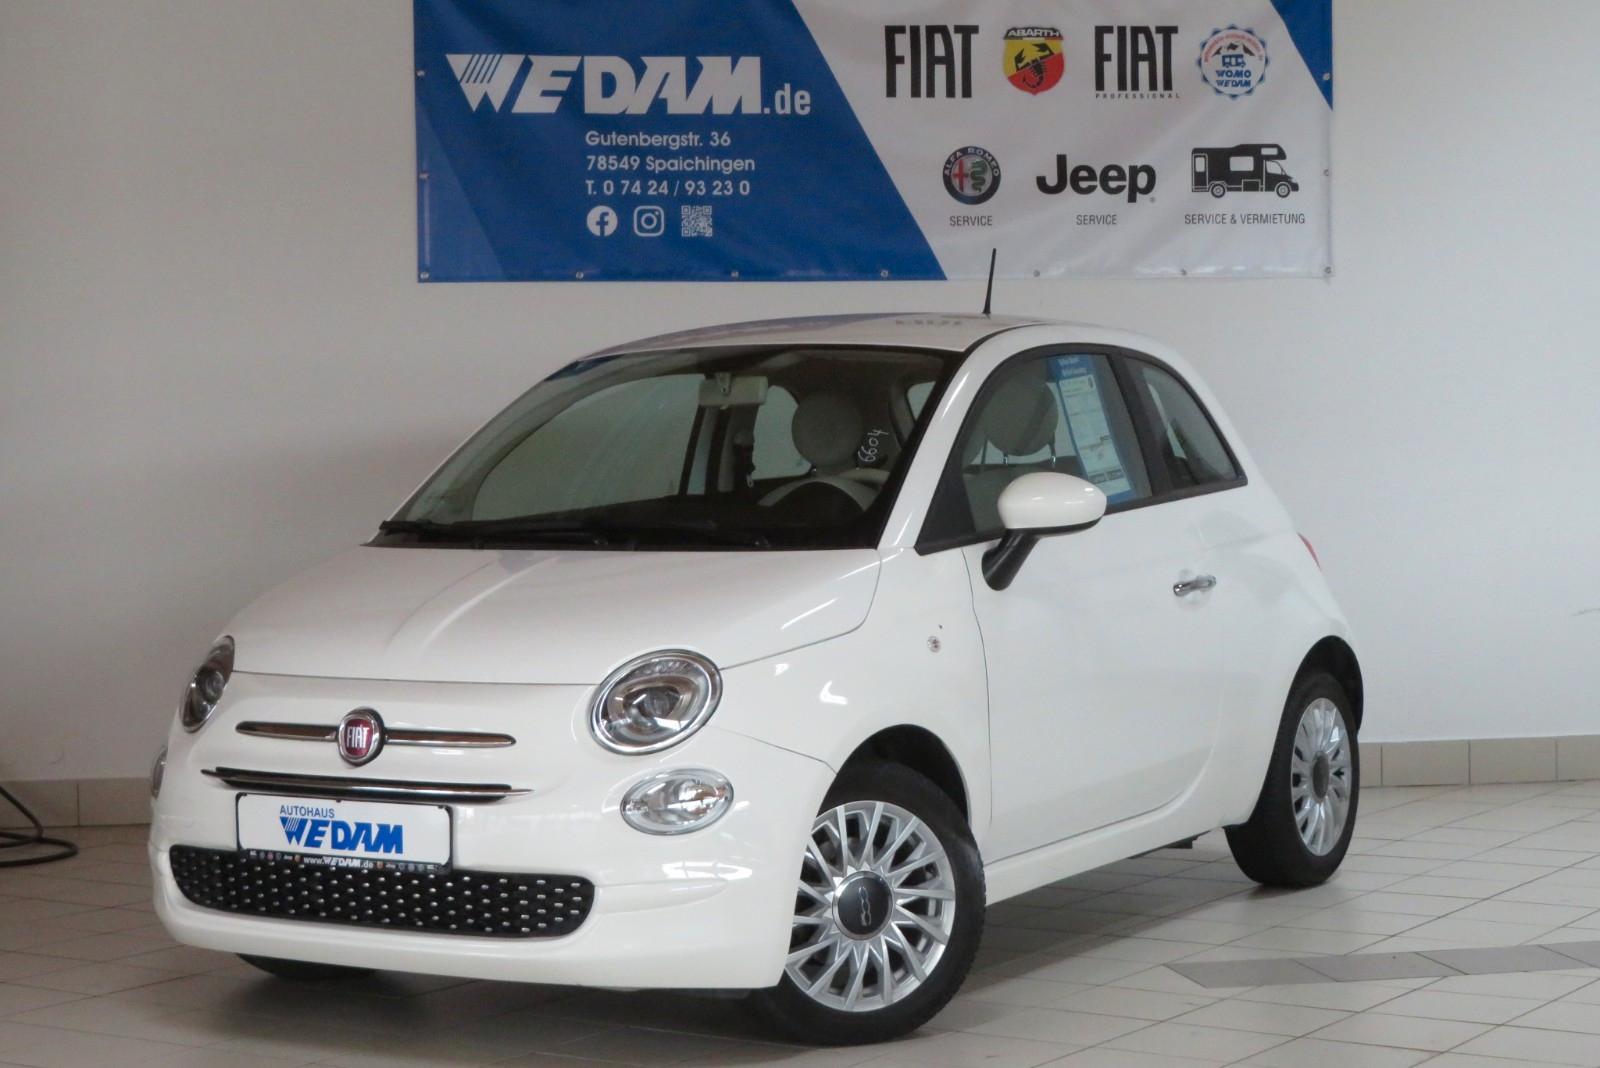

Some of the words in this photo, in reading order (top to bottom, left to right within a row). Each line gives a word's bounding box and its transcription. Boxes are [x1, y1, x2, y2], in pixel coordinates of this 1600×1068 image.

[1007, 28, 1060, 38] ABARTH
[884, 25, 979, 98] FIAT
[1094, 26, 1179, 91] FIAT
[1216, 70, 1251, 78] WOMO
[585, 130, 703, 151] Gutenbergstr.
[709, 131, 731, 147] 36
[586, 155, 641, 171] 78549
[645, 155, 756, 175] Spaichingen
[943, 151, 963, 176] ALFA
[967, 147, 1000, 177] ROMEO
[585, 180, 597, 196] T.
[603, 180, 615, 196] 0
[620, 180, 642, 196] 74
[647, 180, 669, 196] 24
[684, 180, 707, 196] 93
[712, 180, 734, 196] 23
[739, 180, 751, 196] 0
[1036, 154, 1157, 203] Jeep
[949, 214, 993, 226] SERVICE
[1075, 213, 1118, 226] SERVICE
[1184, 213, 1228, 225] SERVICE
[1230, 213, 1238, 225] &
[1240, 212, 1306, 225] VERMIETUNG
[346, 724, 370, 749] FIAT
[279, 804, 335, 818] AUTOHAUS
[279, 816, 404, 854] WEDAM
